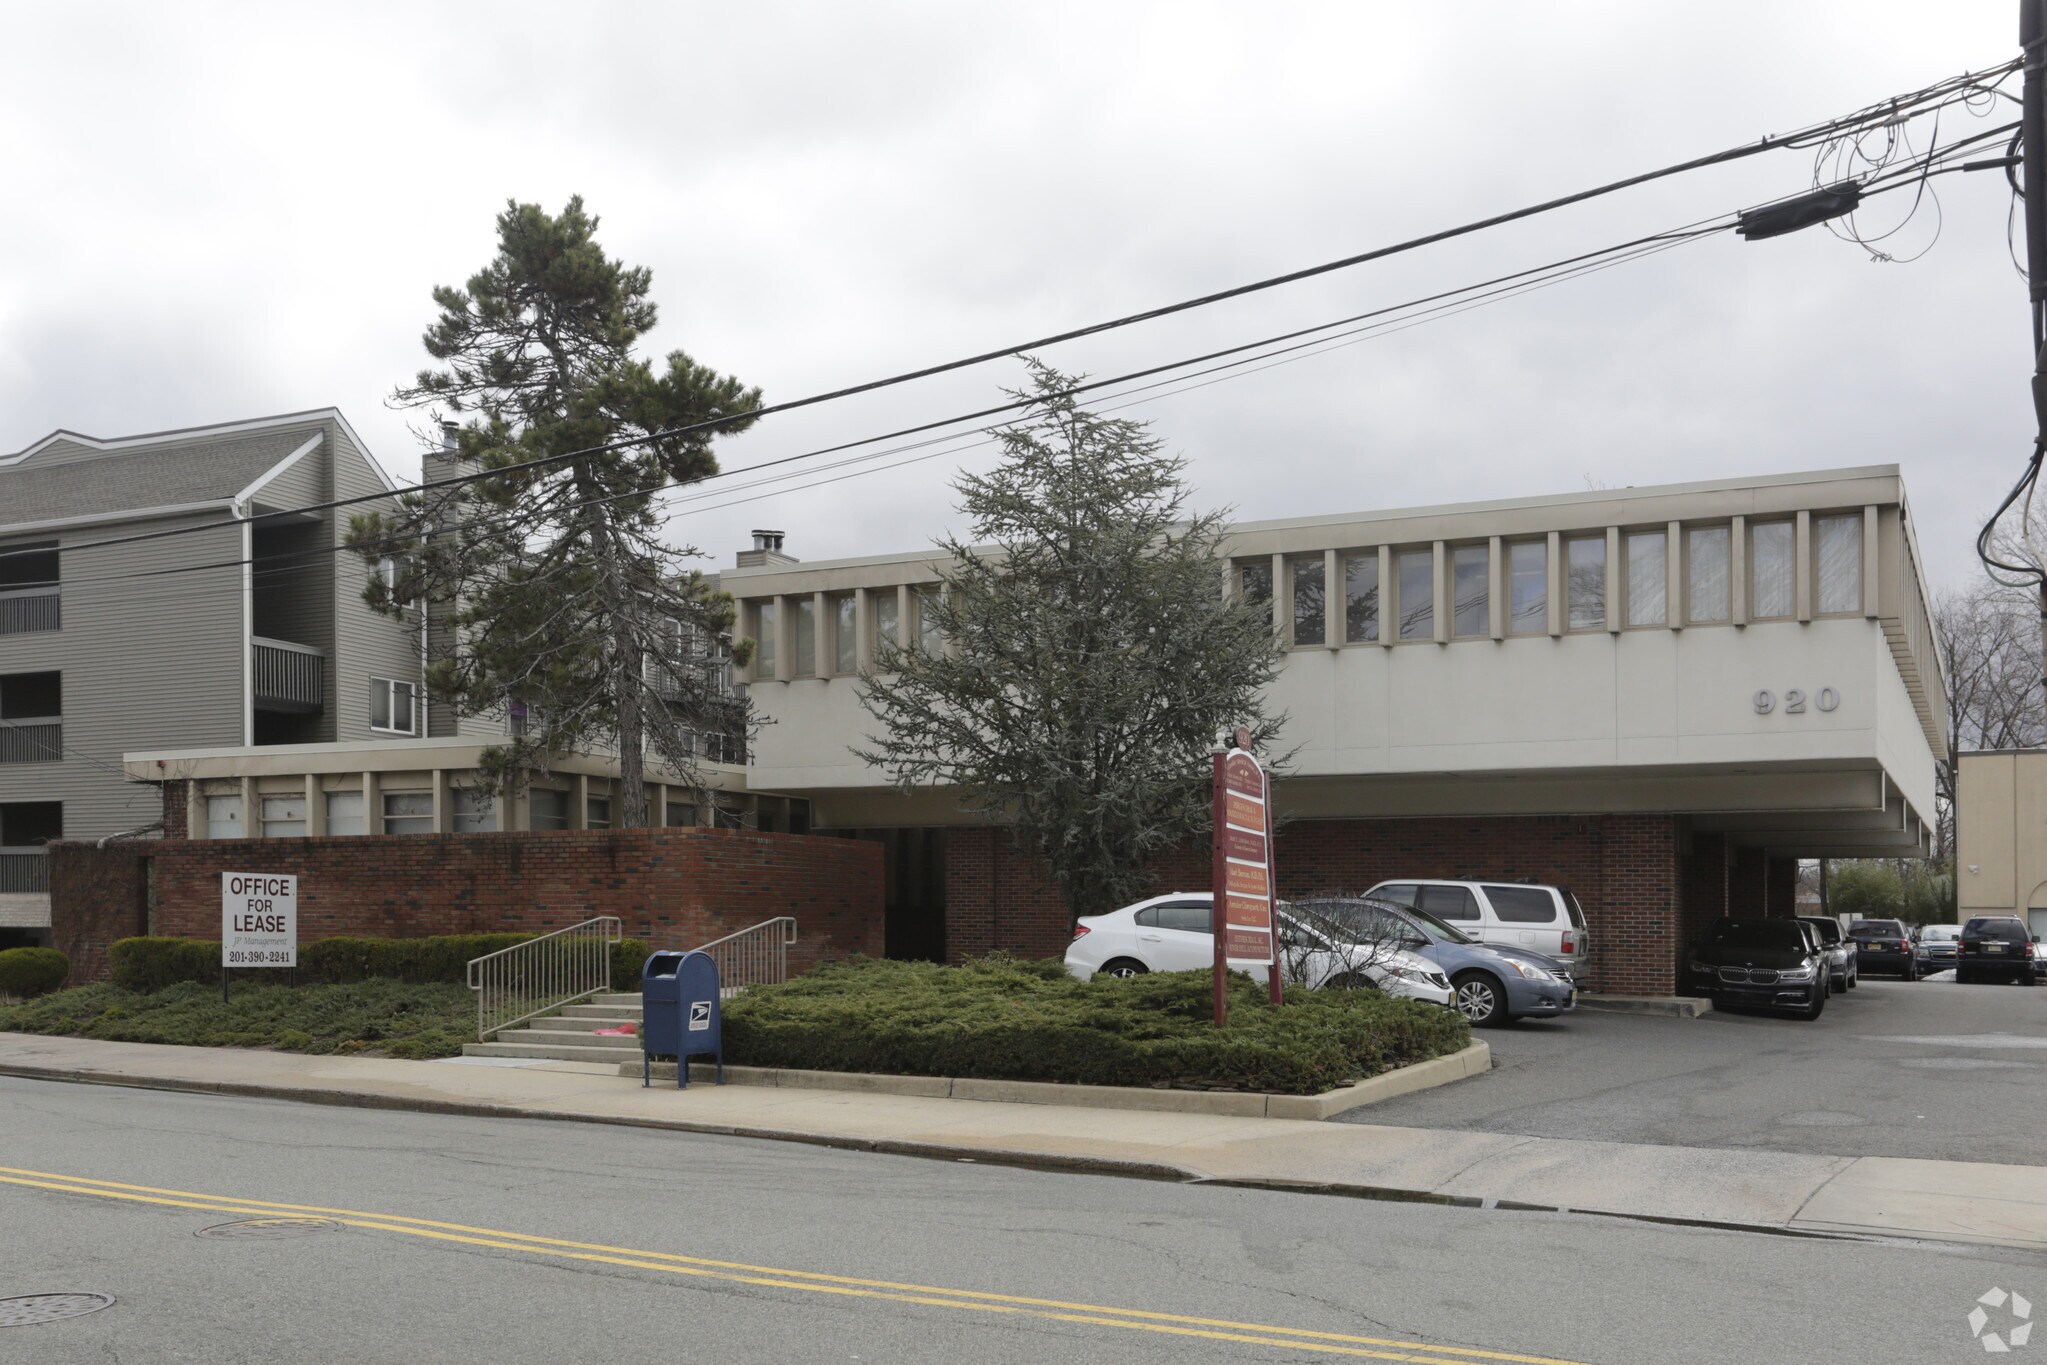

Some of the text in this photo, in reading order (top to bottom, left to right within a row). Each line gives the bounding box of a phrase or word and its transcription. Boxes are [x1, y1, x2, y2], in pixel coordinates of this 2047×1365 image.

[1753, 687, 1840, 715] 920
[231, 877, 289, 896] OFFICE
[248, 899, 272, 912] FOR
[234, 914, 285, 932] LEASE
[244, 936, 287, 948] Management
